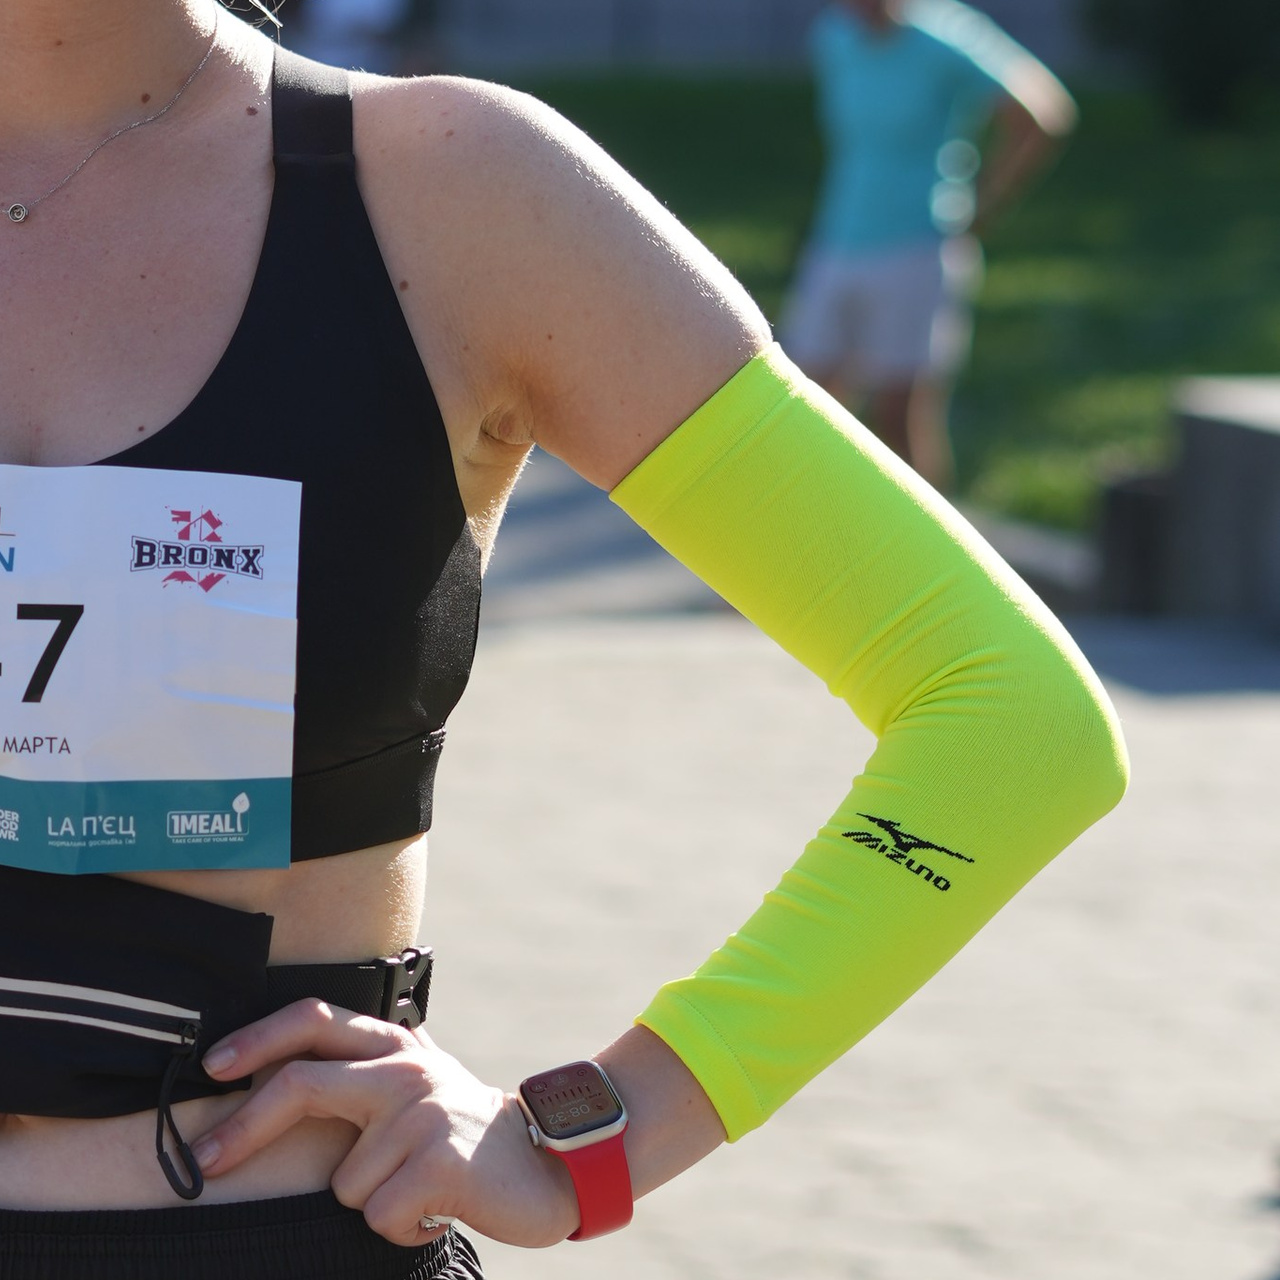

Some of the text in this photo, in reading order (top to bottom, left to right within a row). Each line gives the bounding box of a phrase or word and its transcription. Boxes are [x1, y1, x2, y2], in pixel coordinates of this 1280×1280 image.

[132, 538, 262, 577] BRONX
[3, 736, 72, 754] МАРТА
[47, 816, 75, 836] LA
[546, 1104, 590, 1124] 08:32
